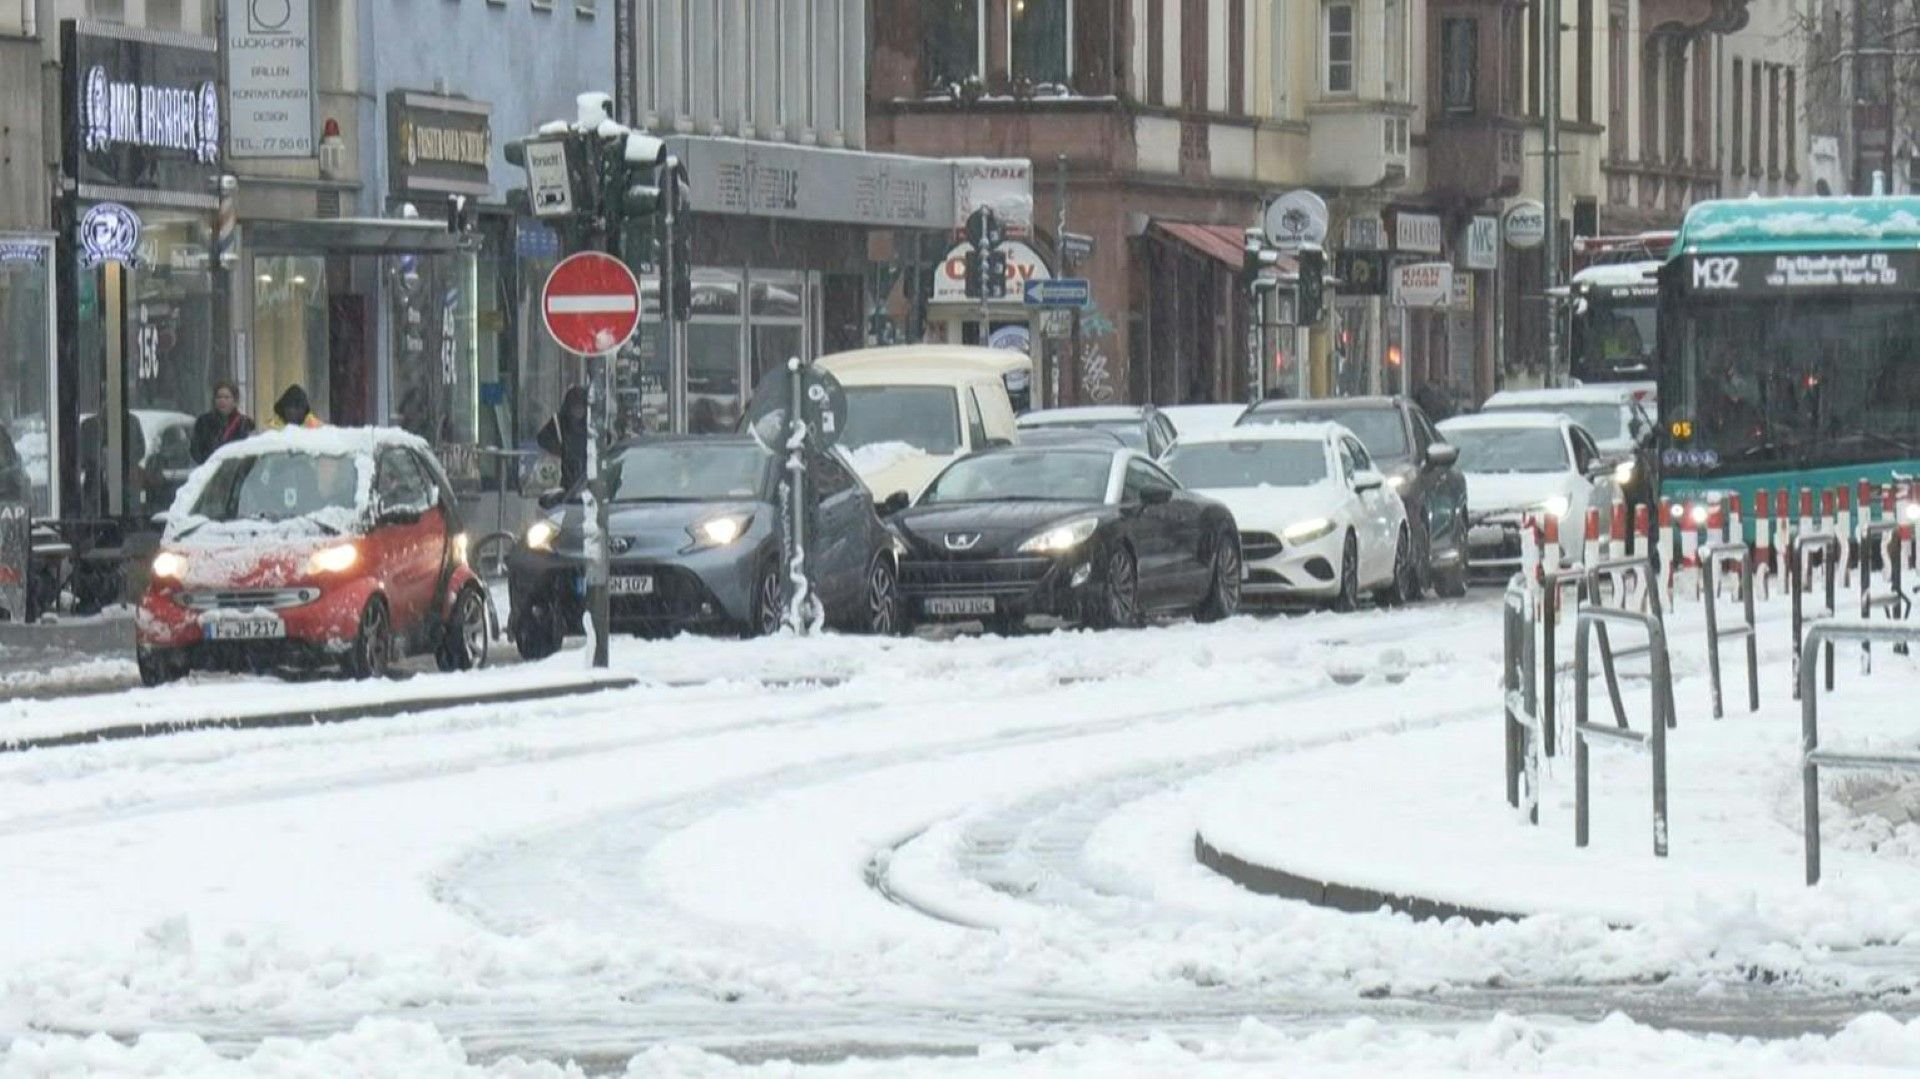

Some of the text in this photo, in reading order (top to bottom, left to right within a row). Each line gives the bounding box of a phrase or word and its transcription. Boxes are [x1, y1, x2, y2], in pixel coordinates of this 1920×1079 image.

[251, 66, 290, 77] BRILLEN
[141, 85, 196, 150] BARBER
[1402, 269, 1440, 280] KHAN
[1693, 258, 1739, 289] M32
[1672, 422, 1692, 437] 05
[253, 621, 278, 637] 217
